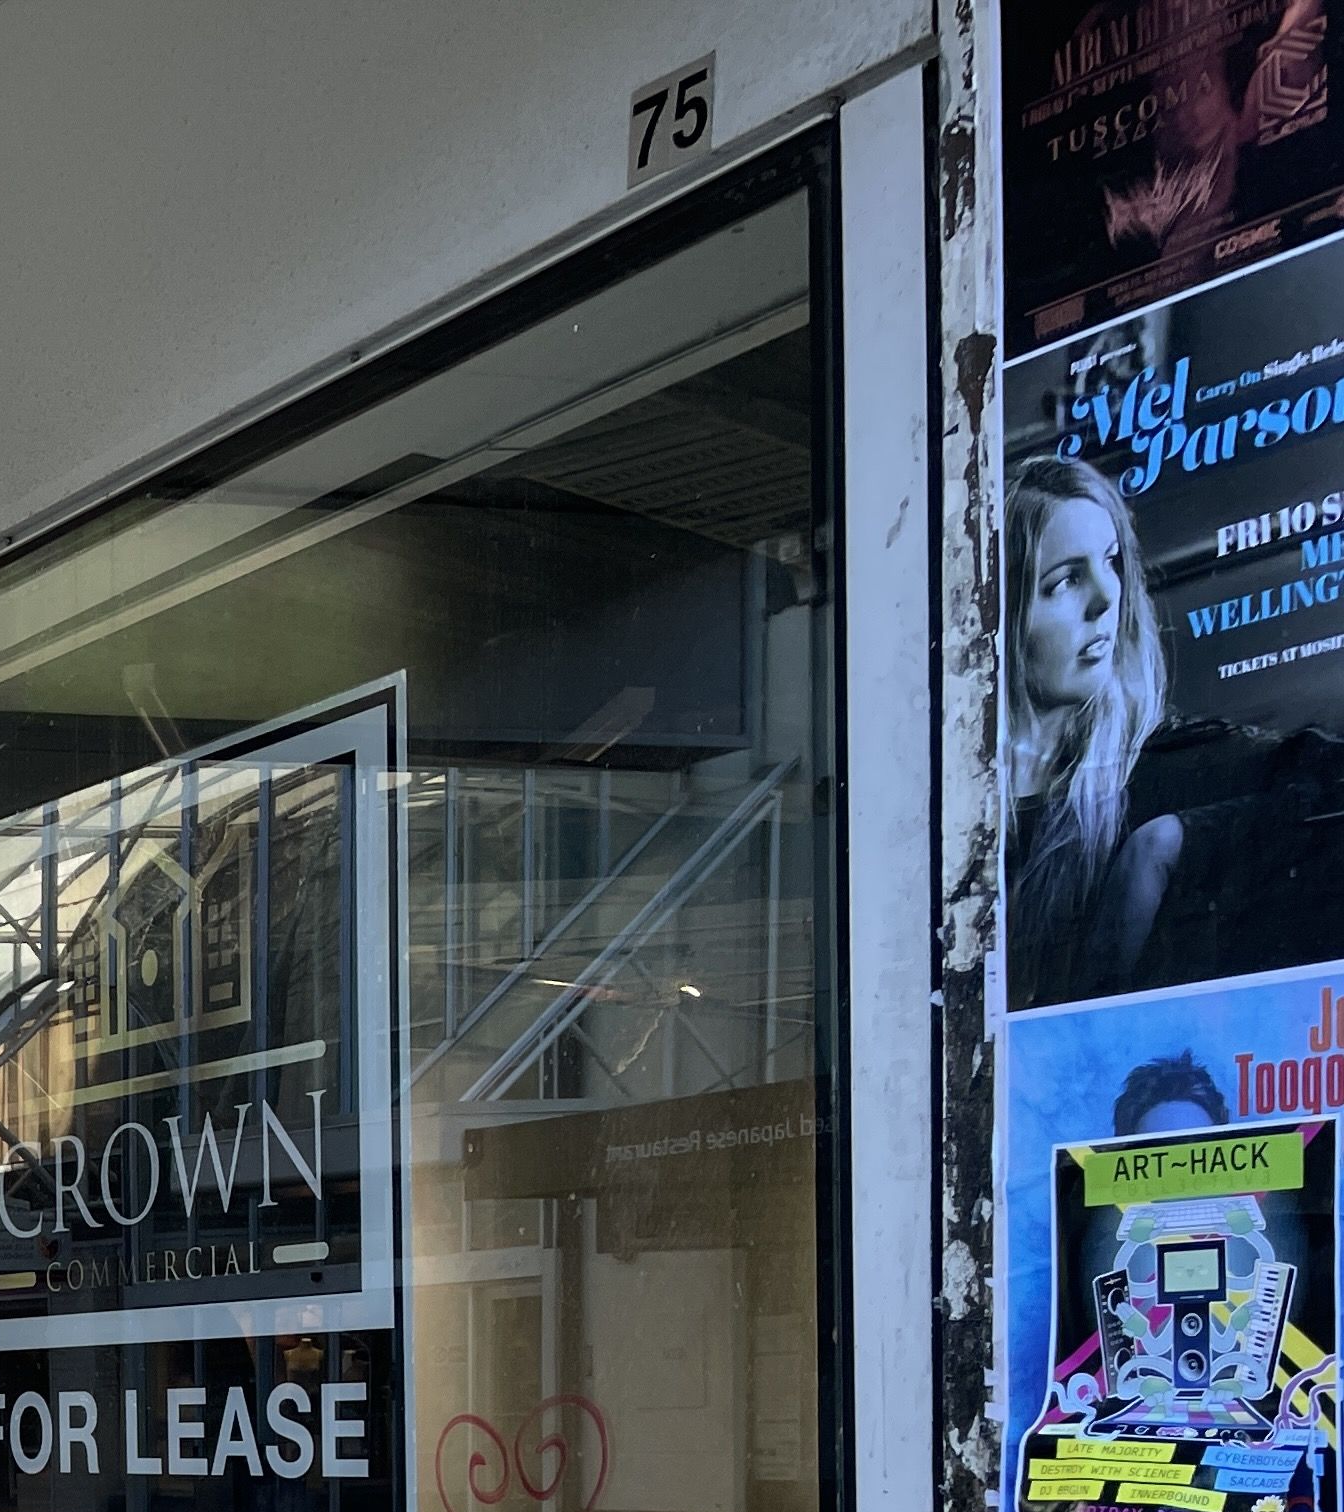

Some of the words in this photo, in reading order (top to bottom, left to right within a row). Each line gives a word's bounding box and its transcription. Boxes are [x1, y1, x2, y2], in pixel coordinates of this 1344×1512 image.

[632, 67, 708, 170] 75
[1196, 380, 1236, 402] Carry
[1239, 371, 1262, 388] On
[1057, 357, 1190, 464] Mel
[1216, 512, 1272, 558] FRI
[1218, 651, 1278, 679] TICKETS
[1280, 646, 1297, 662] AT
[45, 1240, 262, 1294] COMMERCIAL
[125, 1382, 370, 1480] LEASE
[1066, 1443, 1095, 1454] LATE
[1101, 1445, 1163, 1457] MAJORITY
[1215, 1451, 1297, 1467] CYBERBOY666
[1040, 1464, 1085, 1475] DESTROY
[1090, 1465, 1122, 1476] WITH
[1128, 1468, 1182, 1480] SCIENCE
[1229, 1475, 1286, 1489] SACCADES
[1039, 1485, 1053, 1496] DJ
[1130, 1488, 1210, 1506] INNERBOUND
